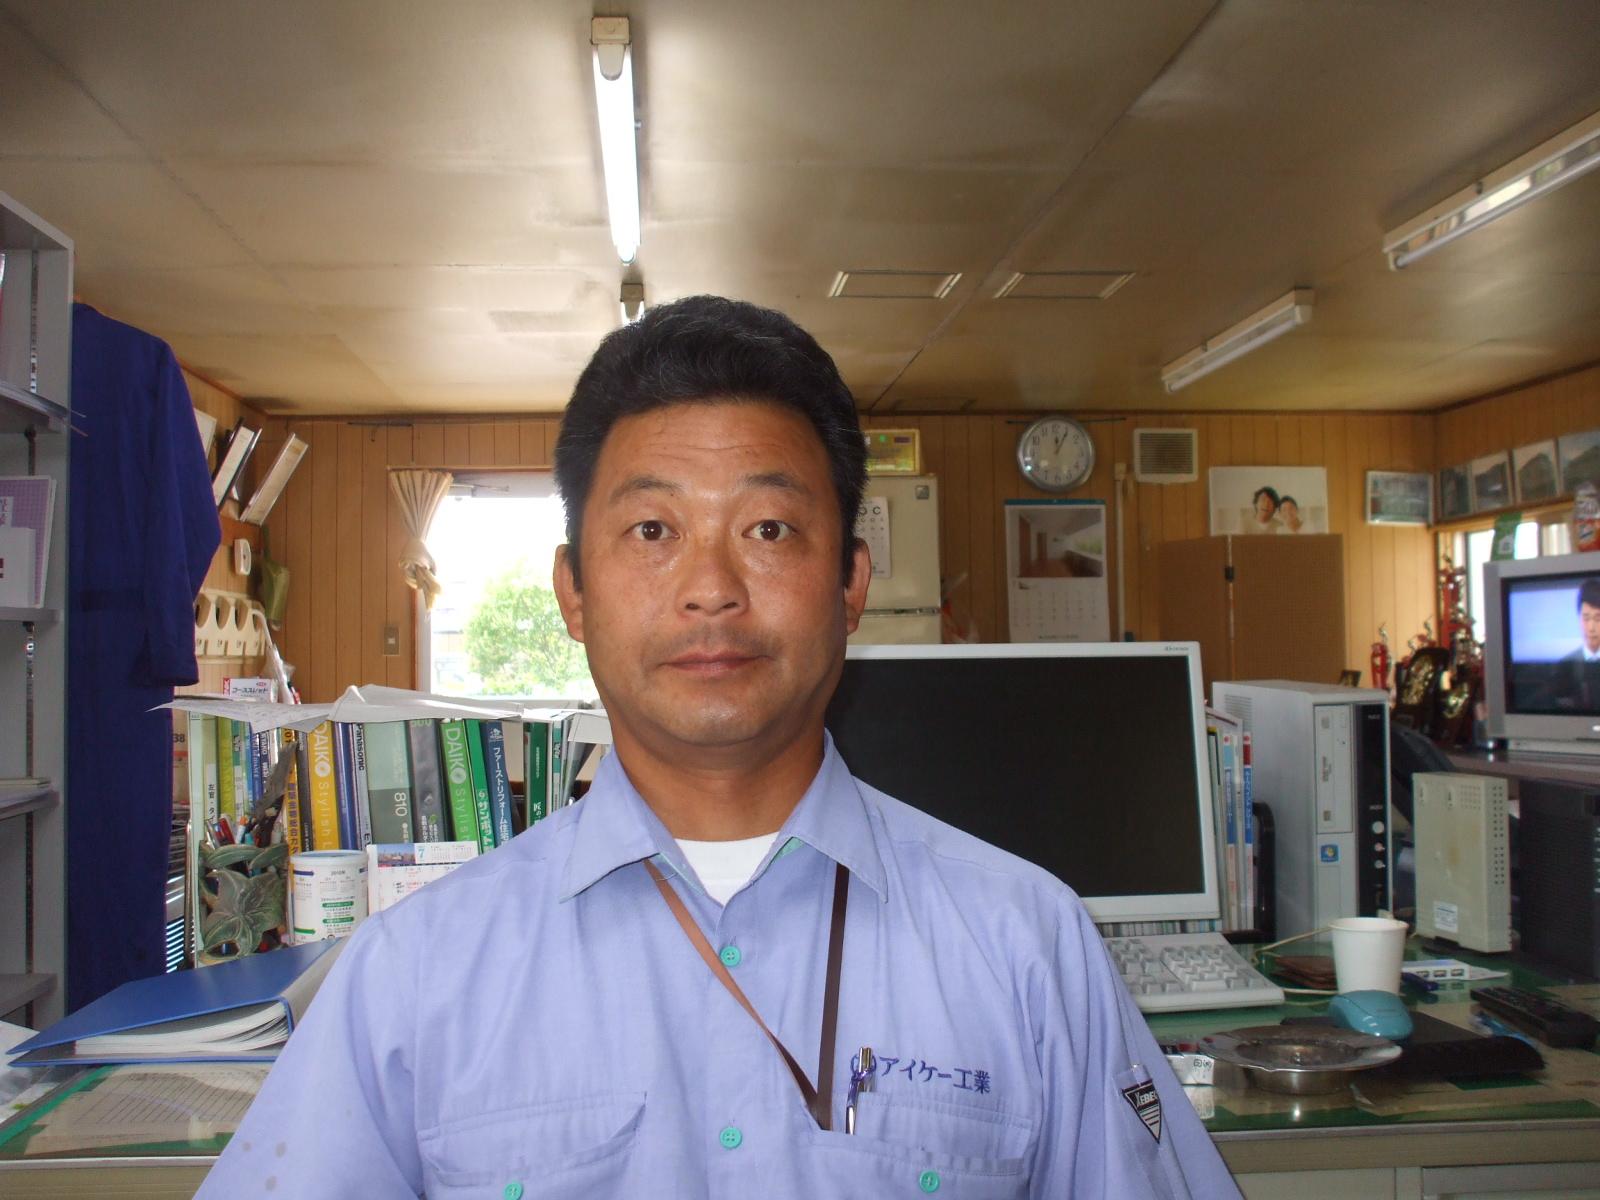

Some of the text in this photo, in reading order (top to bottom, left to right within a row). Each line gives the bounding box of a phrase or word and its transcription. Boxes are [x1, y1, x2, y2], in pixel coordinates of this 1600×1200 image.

[356, 723, 366, 771] Panasonic
[446, 727, 467, 785] DAIKO
[394, 791, 408, 817] 810
[850, 1053, 991, 1095] アイケー工業
